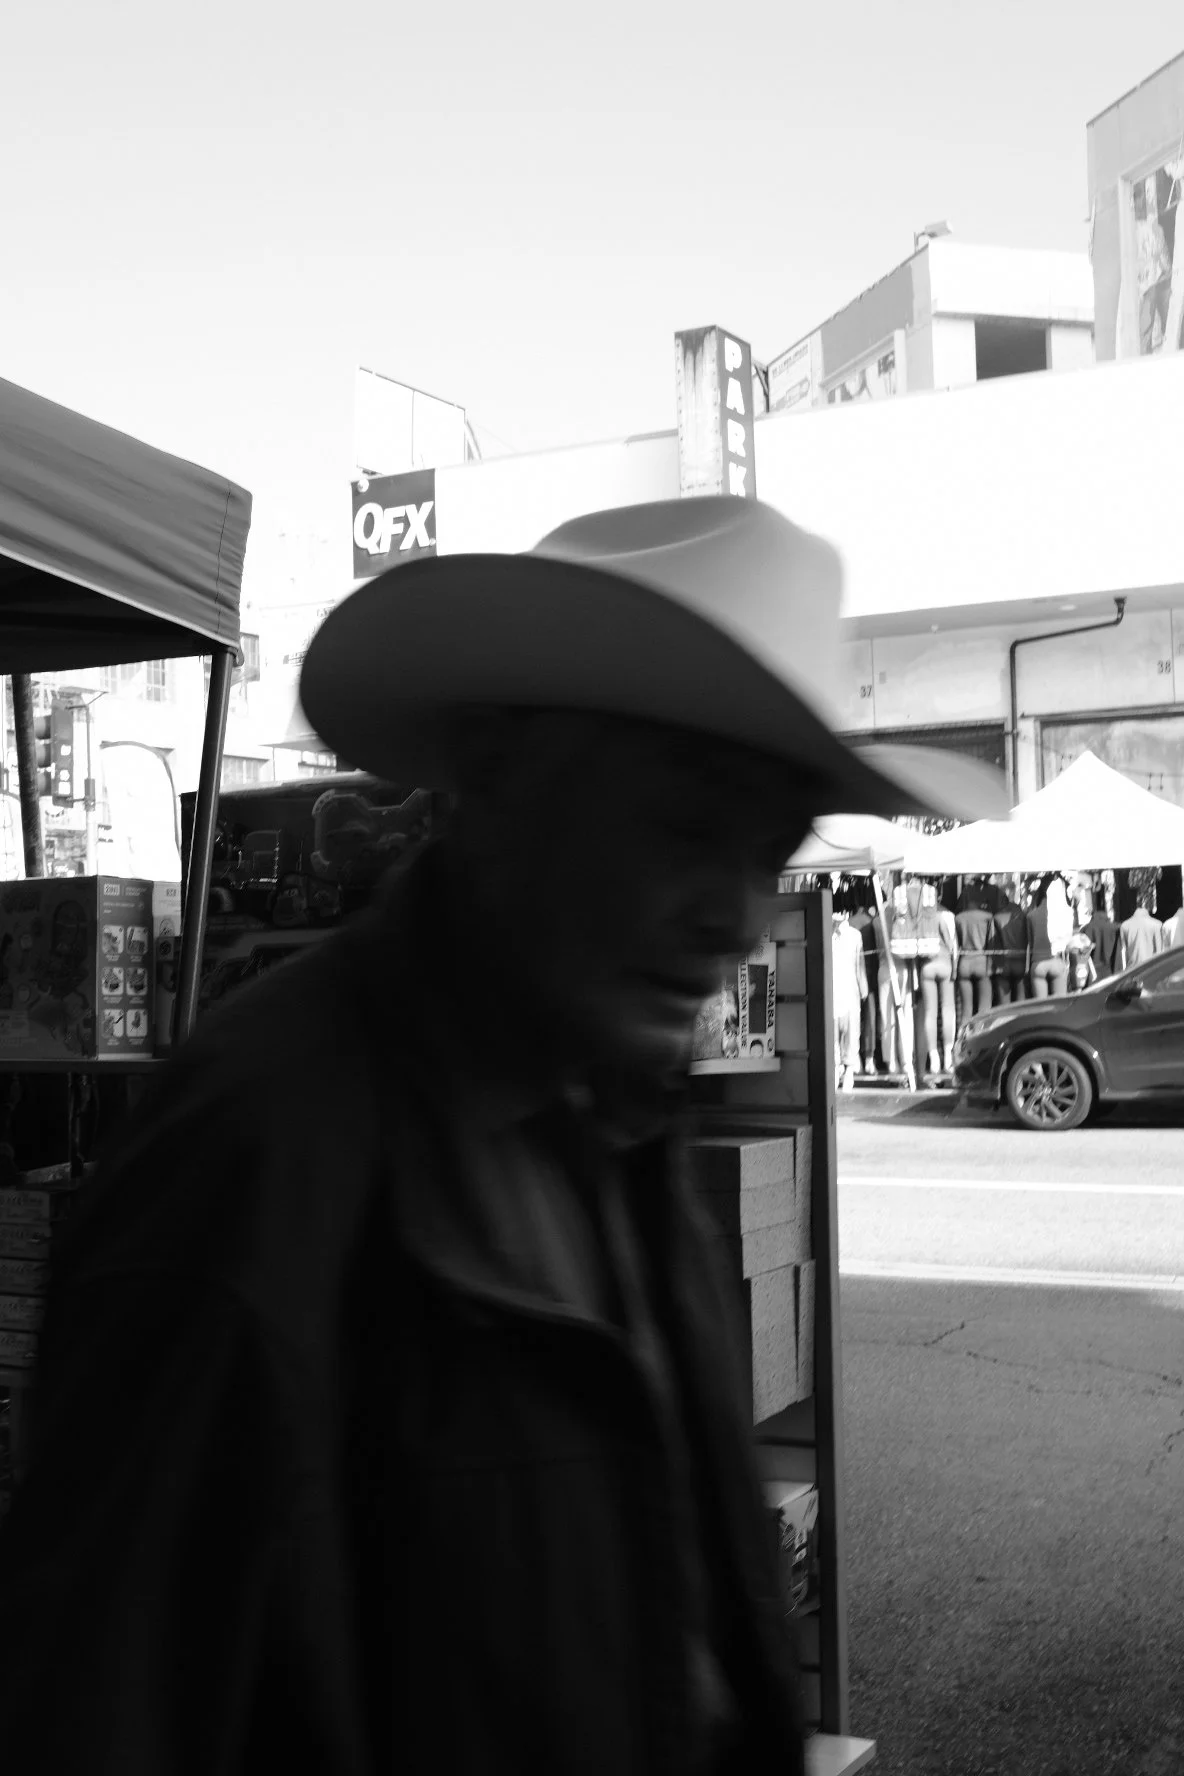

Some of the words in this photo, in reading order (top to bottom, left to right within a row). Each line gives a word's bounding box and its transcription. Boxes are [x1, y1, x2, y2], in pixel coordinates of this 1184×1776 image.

[724, 337, 746, 498] PARK
[353, 500, 434, 555] QFX
[860, 685, 872, 698] 37
